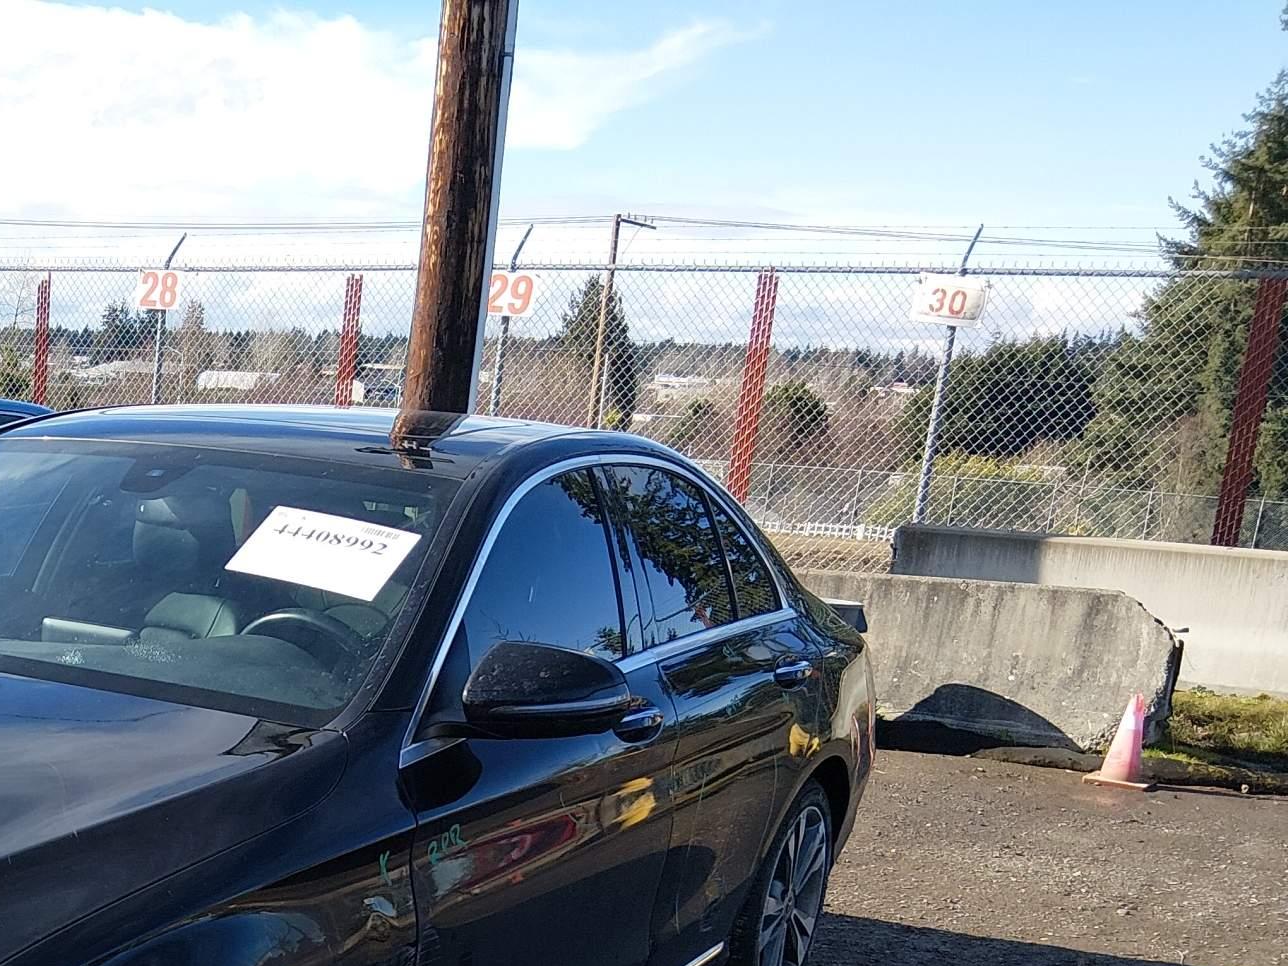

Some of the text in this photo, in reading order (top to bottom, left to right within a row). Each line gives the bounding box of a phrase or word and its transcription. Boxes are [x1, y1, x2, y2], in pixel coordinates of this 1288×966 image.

[140, 272, 178, 308] 28
[488, 274, 533, 315] 29
[929, 288, 967, 315] 30
[273, 523, 388, 556] 44408992
